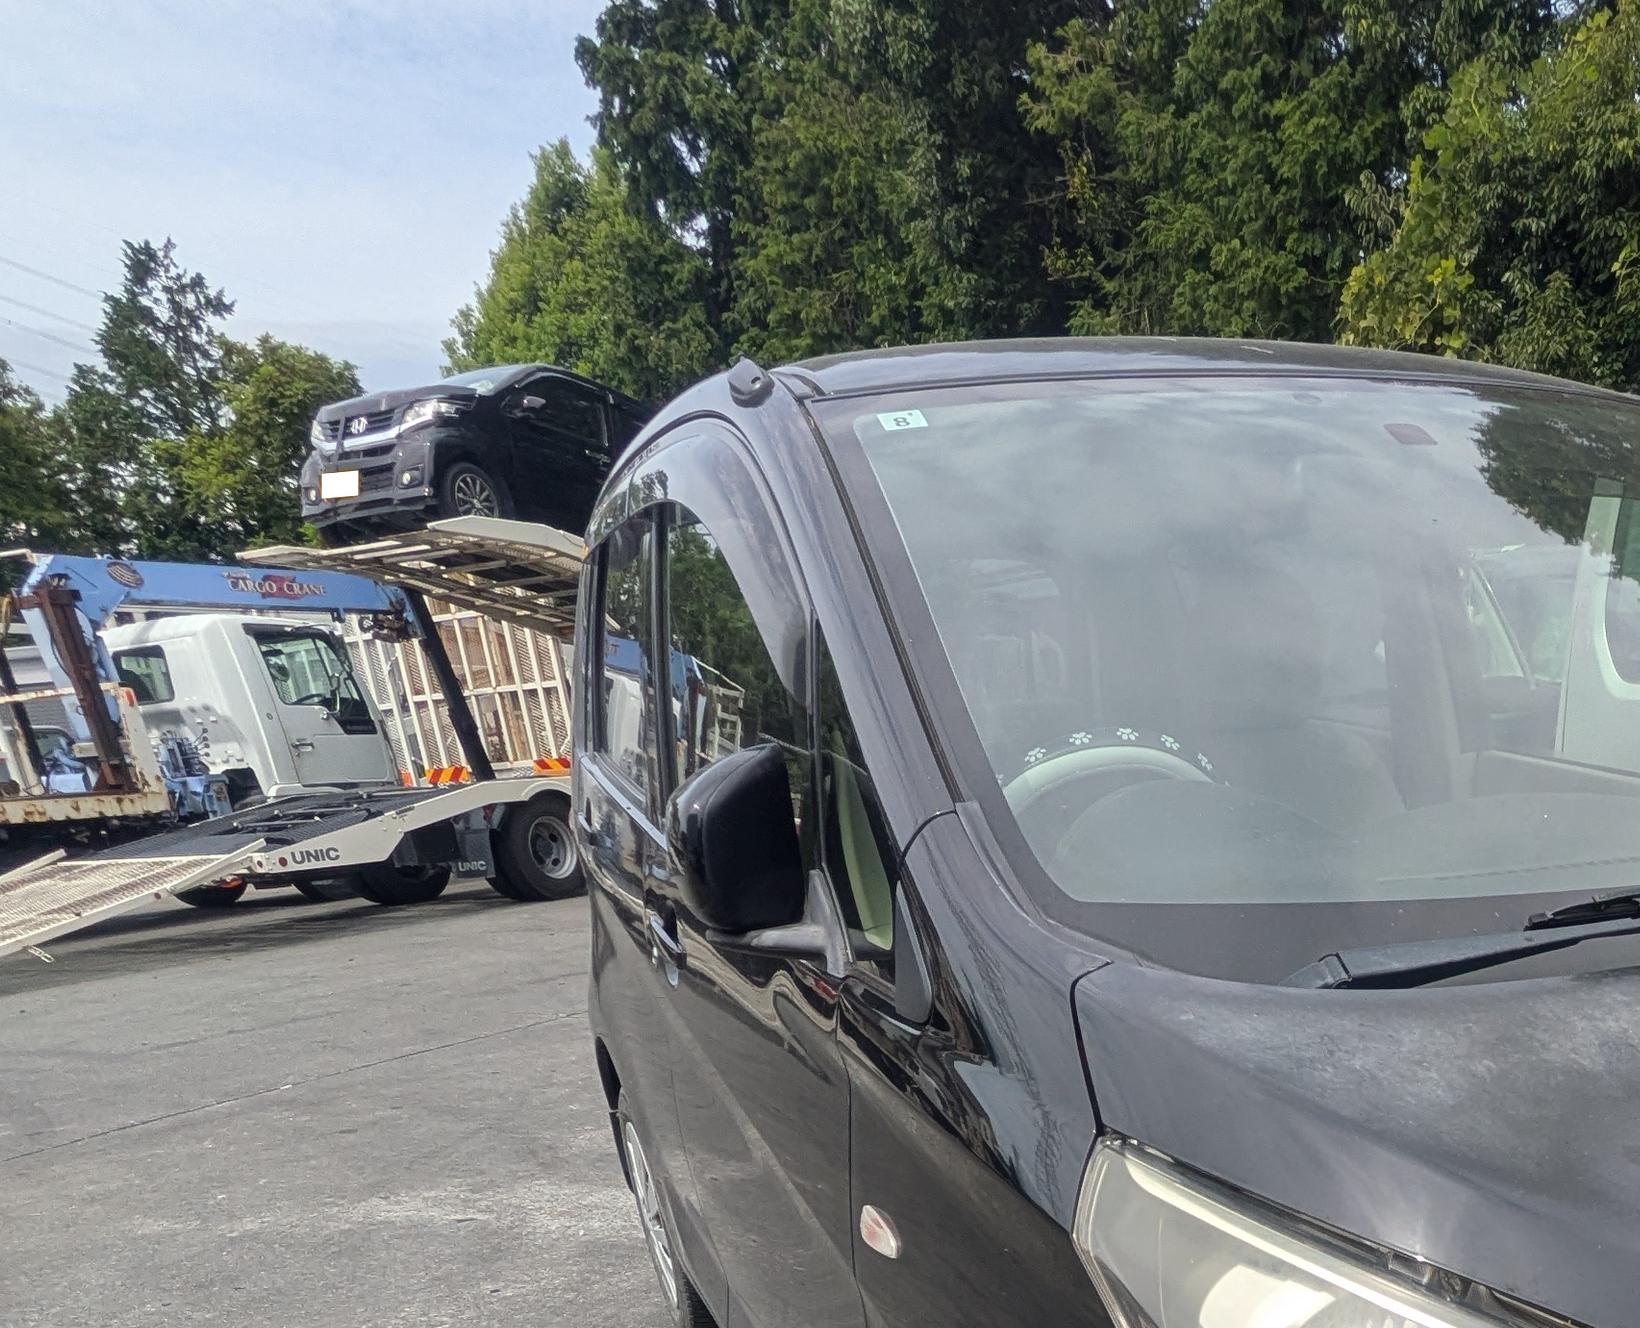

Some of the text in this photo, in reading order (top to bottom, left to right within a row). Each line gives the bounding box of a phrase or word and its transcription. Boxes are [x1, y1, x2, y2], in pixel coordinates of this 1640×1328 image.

[228, 578, 327, 596] CARGO CRANE
[290, 847, 341, 865] UNIC
[458, 860, 488, 872] UNIC
